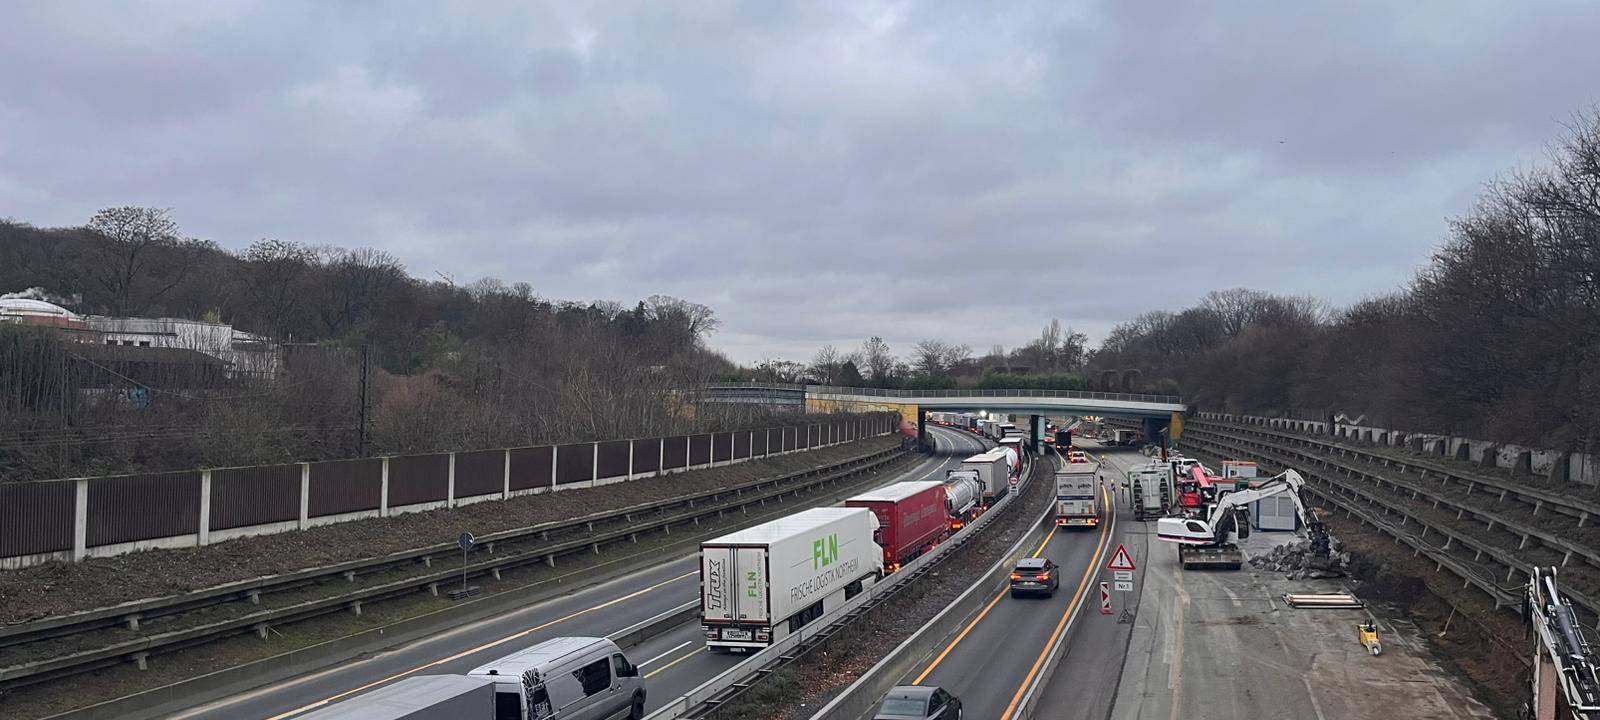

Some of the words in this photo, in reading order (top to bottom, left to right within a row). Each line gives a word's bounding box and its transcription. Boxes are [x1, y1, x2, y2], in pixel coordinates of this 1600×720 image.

[813, 533, 838, 570] FLN
[707, 559, 721, 610] Trux
[747, 572, 757, 597] FLN
[790, 579, 813, 604] FRISCHE
[813, 570, 836, 592] LOGISTIK
